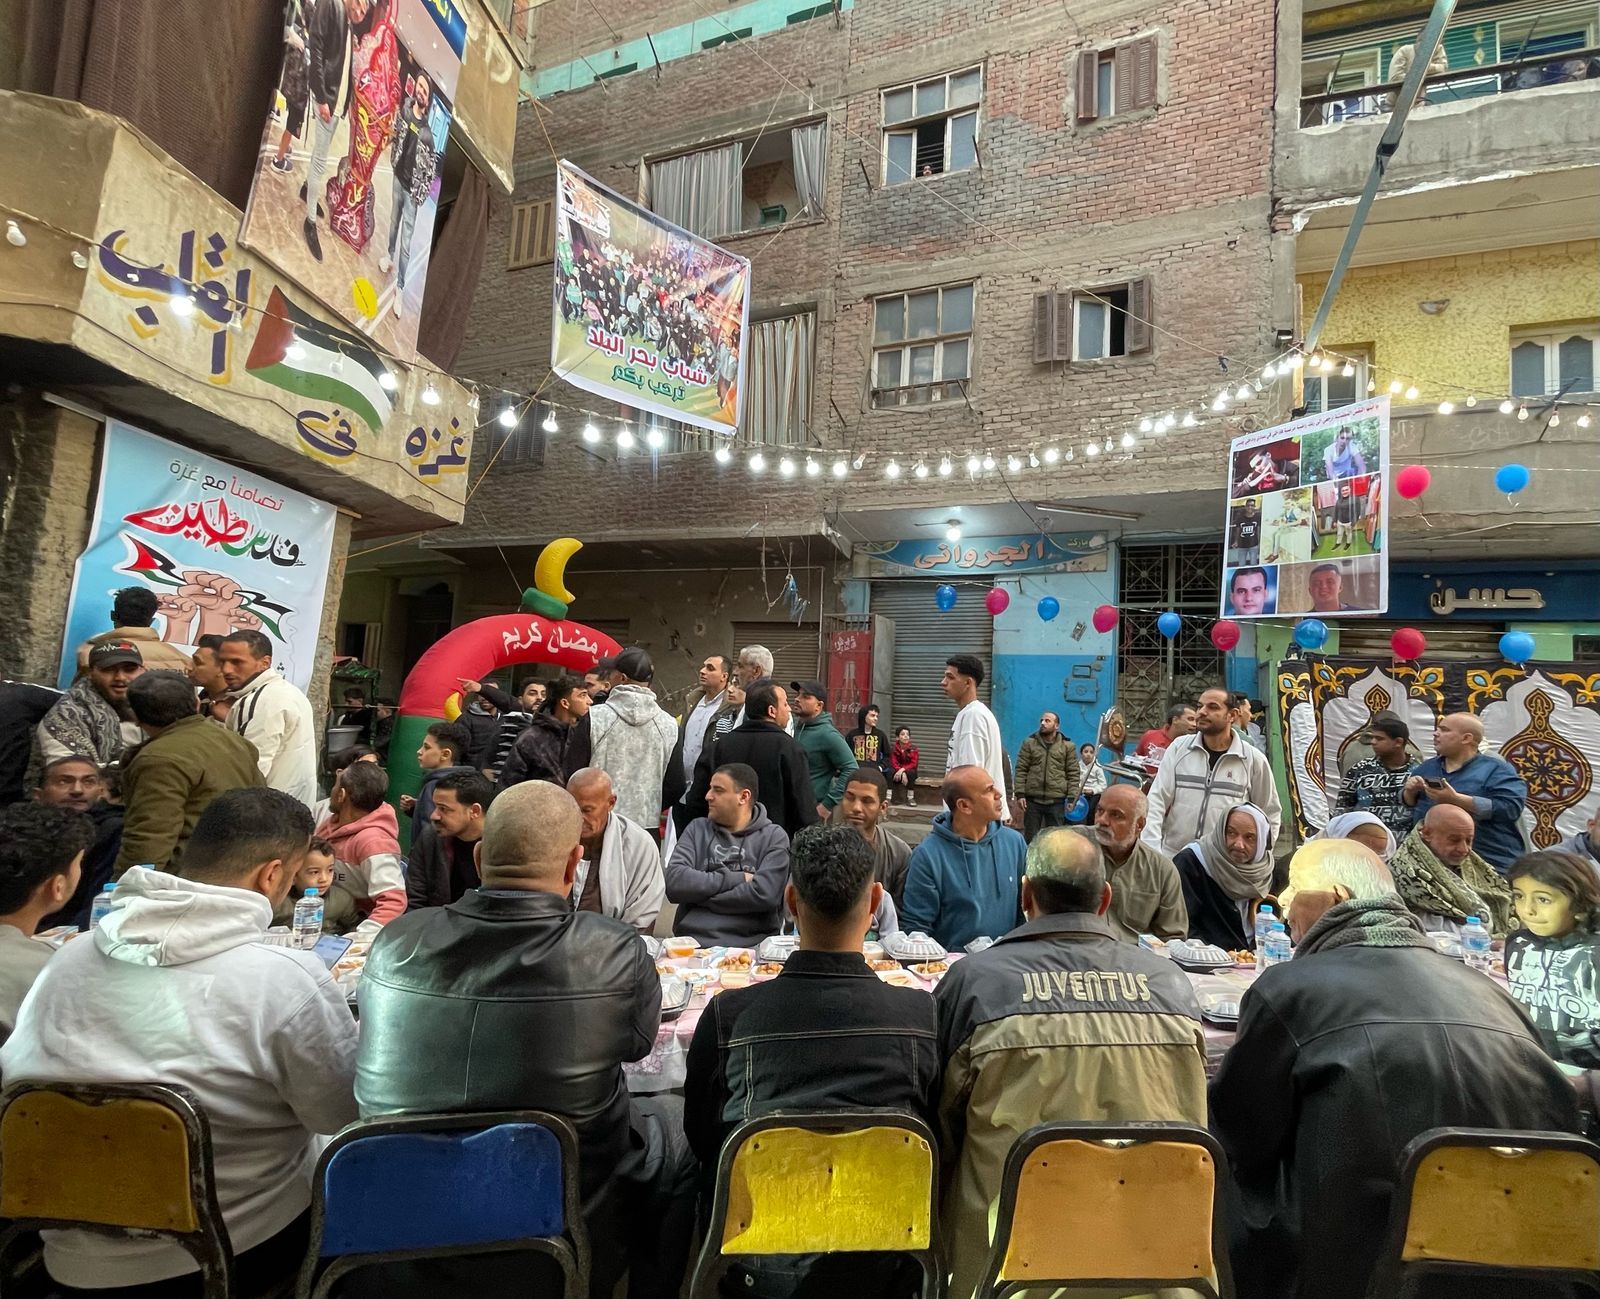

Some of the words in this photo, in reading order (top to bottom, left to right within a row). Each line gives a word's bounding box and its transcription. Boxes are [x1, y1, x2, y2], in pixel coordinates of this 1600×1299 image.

[587, 326, 625, 356] البلد
[628, 345, 658, 372] بحر
[662, 359, 709, 386] شباب
[611, 365, 645, 390] بكم
[405, 416, 467, 481] غزه
[169, 459, 200, 482] غزة
[201, 474, 227, 491] مع
[123, 497, 307, 567] فلسطين
[1430, 580, 1546, 615] حسن
[502, 621, 543, 657] كريم
[1022, 970, 1151, 1002] JUVENTUS
